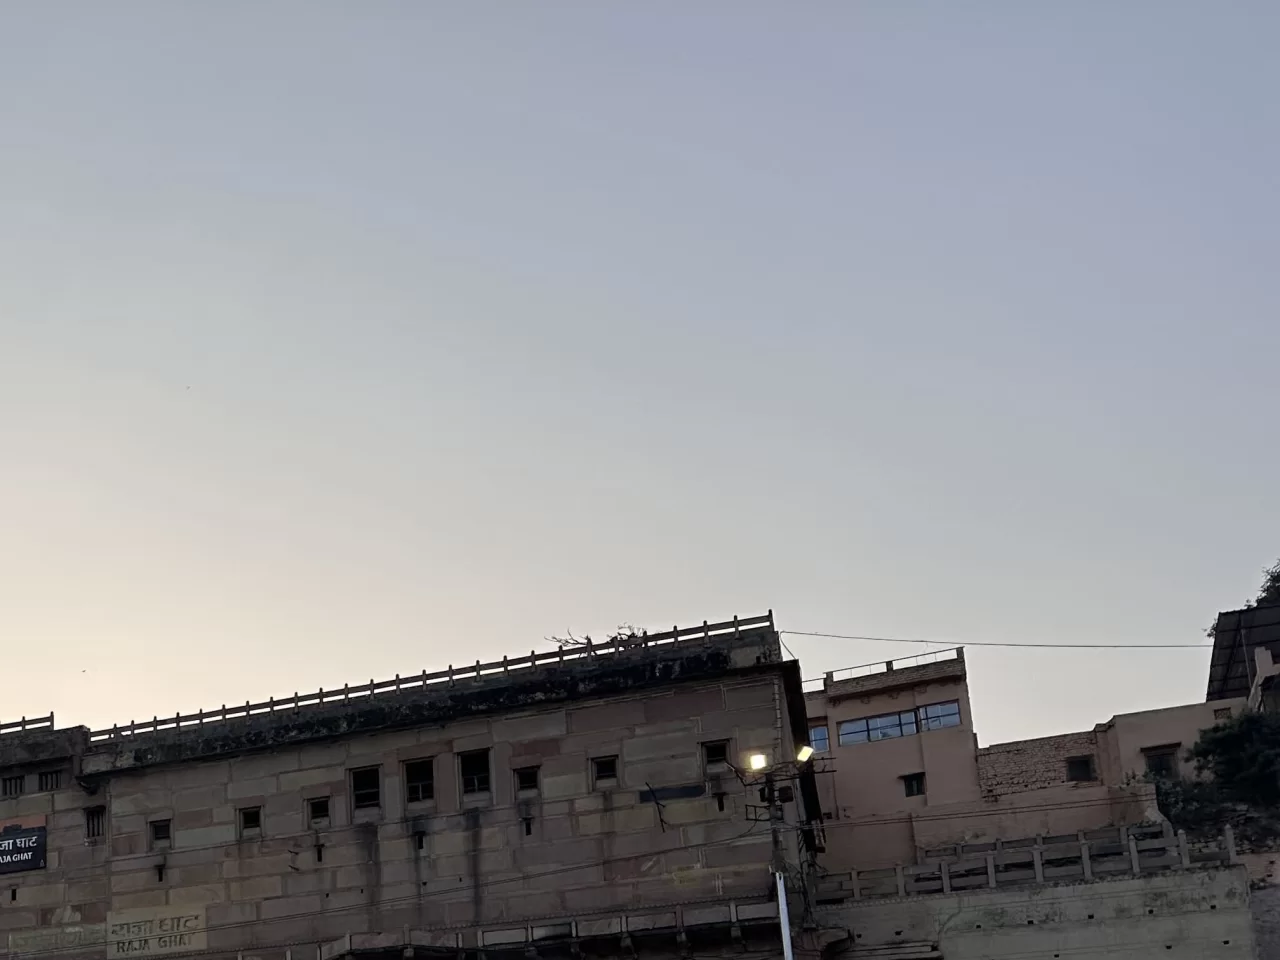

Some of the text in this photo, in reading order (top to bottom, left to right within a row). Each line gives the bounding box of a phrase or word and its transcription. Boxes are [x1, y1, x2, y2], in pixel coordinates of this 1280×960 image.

[16, 836, 38, 848] घाट
[12, 852, 33, 862] GHAT
[158, 914, 202, 932] घाट
[116, 939, 150, 953] RAJA
[157, 932, 196, 949] GHAT
